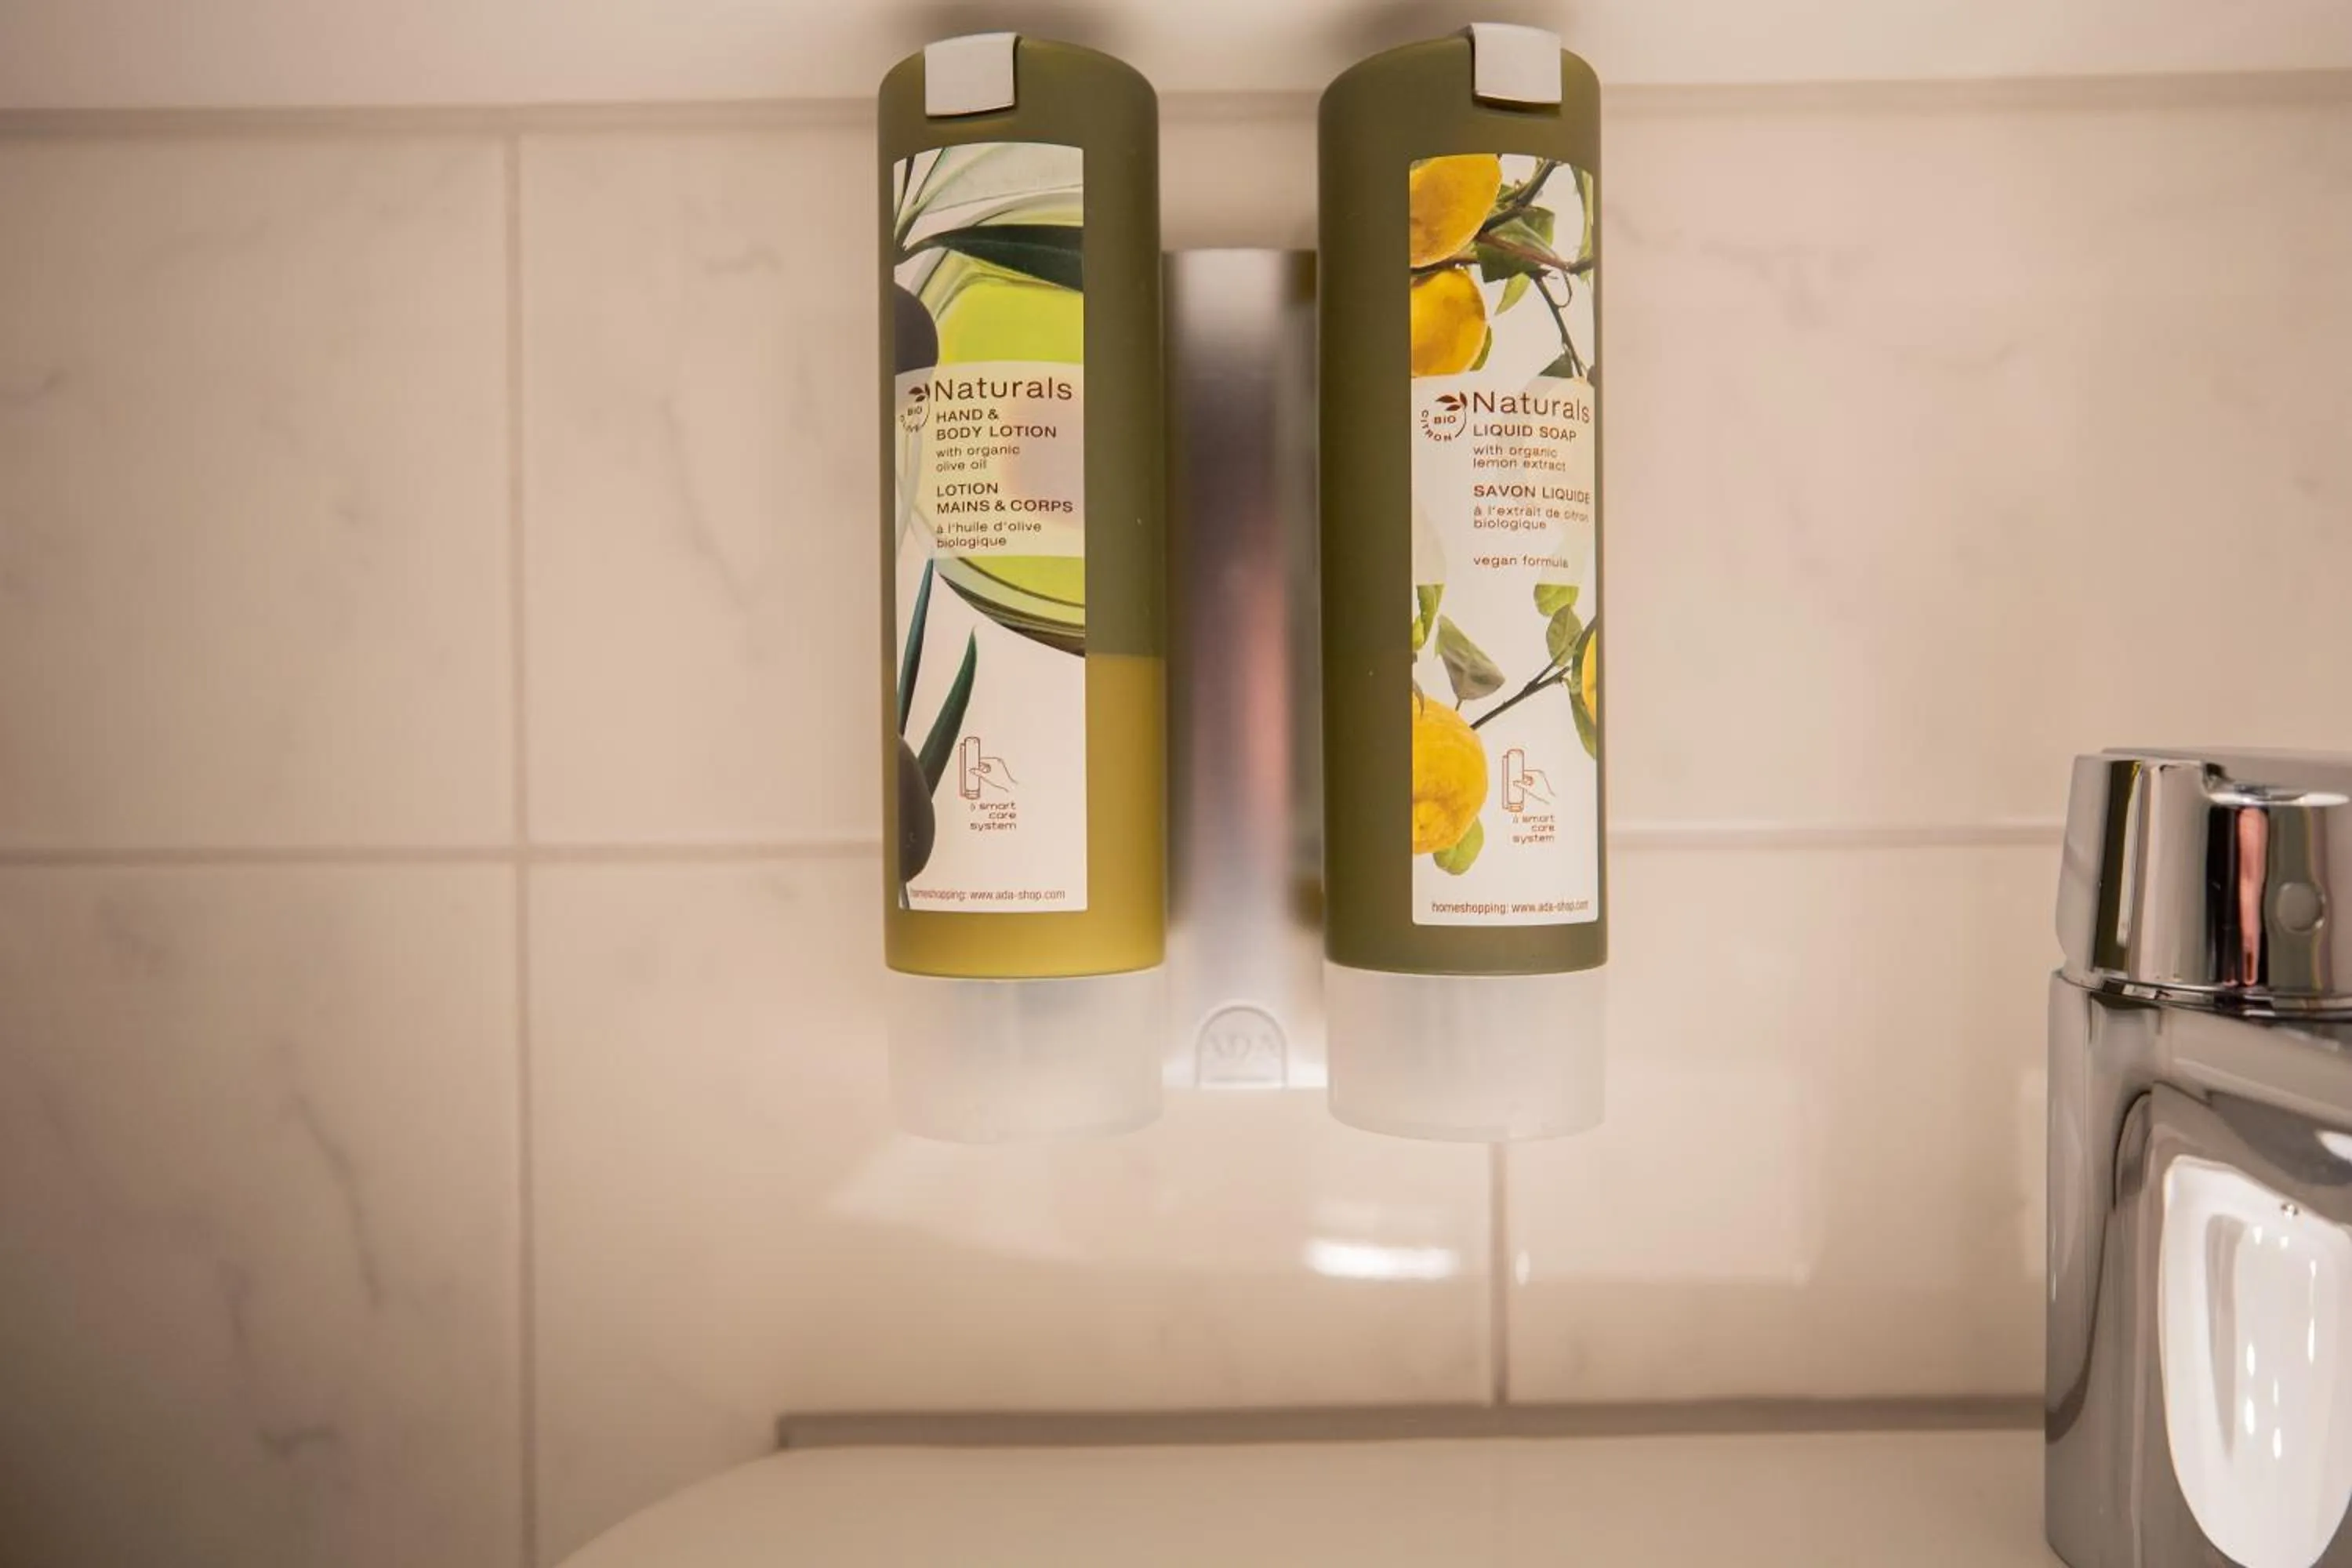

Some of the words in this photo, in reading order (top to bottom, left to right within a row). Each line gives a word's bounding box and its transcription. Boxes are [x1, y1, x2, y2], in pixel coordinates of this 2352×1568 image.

[935, 377, 1073, 401] Naturals
[1473, 391, 1590, 424] Naturals
[936, 408, 983, 423] HAND
[988, 408, 999, 420] &
[1434, 416, 1456, 424] BIO
[936, 426, 982, 441] BODY
[990, 426, 1057, 437] LOTION
[1473, 424, 1533, 437] LIQUID
[1539, 426, 1577, 443] SOAP
[936, 447, 962, 458] with
[967, 445, 1020, 458] organic
[1473, 445, 1503, 456] with
[1509, 447, 1558, 459] organic
[936, 461, 965, 472] olive
[970, 460, 987, 470] oil
[1473, 459, 1517, 469] lemon
[1523, 459, 1566, 472] extract
[937, 482, 998, 497] LOTION
[1473, 485, 1536, 498] SAVON
[1542, 487, 1591, 504] LIQUIDE
[937, 499, 990, 514] MAINS
[994, 500, 1006, 512] &
[1011, 499, 1073, 514] CORPS
[1545, 508, 1560, 518] de
[1473, 519, 1546, 532] biologique
[937, 537, 1007, 549] biologique
[1473, 557, 1517, 568] vegan
[1523, 556, 1568, 568] formula
[979, 801, 1016, 810] smart
[970, 822, 1017, 831] system
[1512, 834, 1555, 844] system
[1432, 901, 1508, 915] homeshopping:
